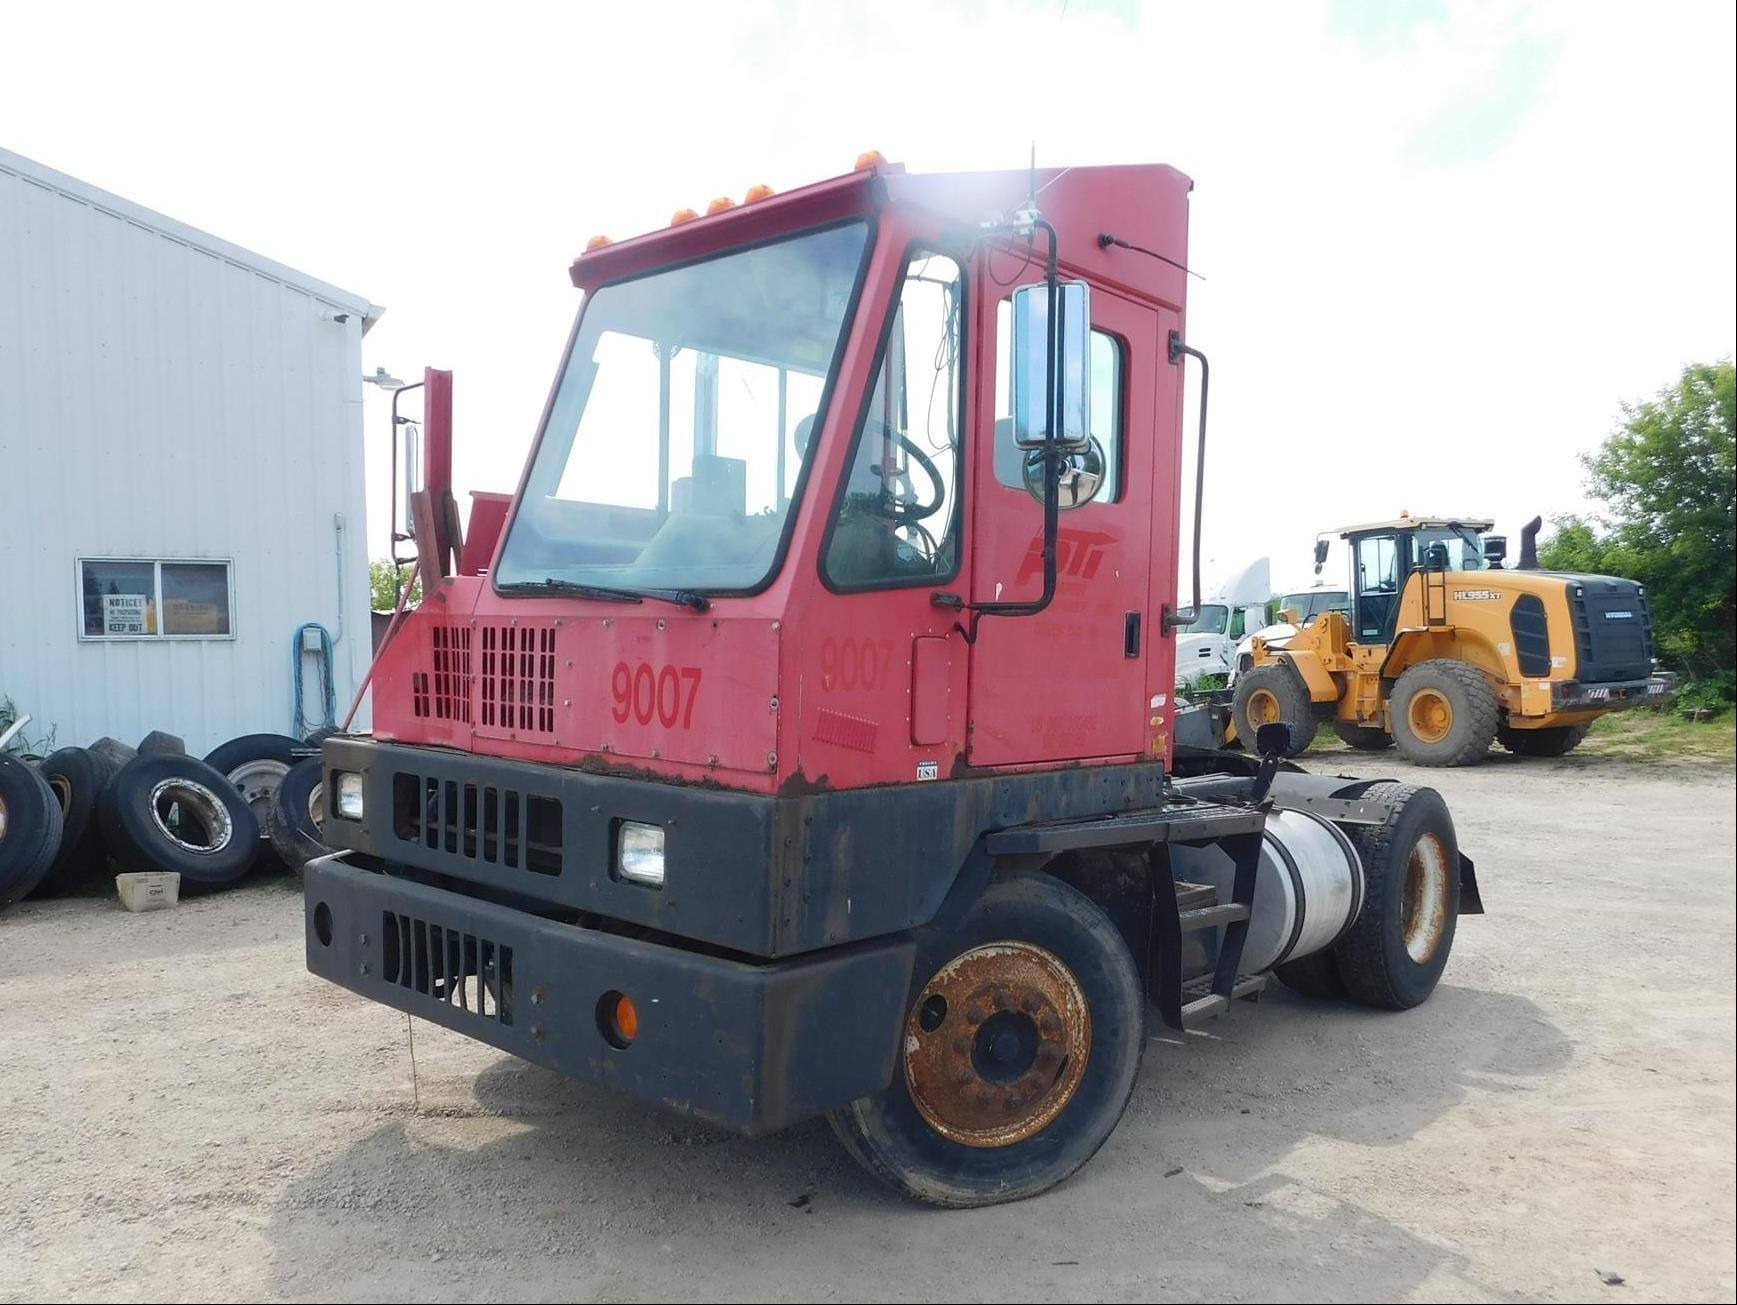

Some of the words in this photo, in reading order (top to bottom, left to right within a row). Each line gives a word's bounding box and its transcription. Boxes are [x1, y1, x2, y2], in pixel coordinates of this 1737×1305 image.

[109, 623, 126, 632] KEEP
[128, 623, 143, 632] OUT
[821, 636, 894, 692] 9007
[611, 661, 702, 730] 9007
